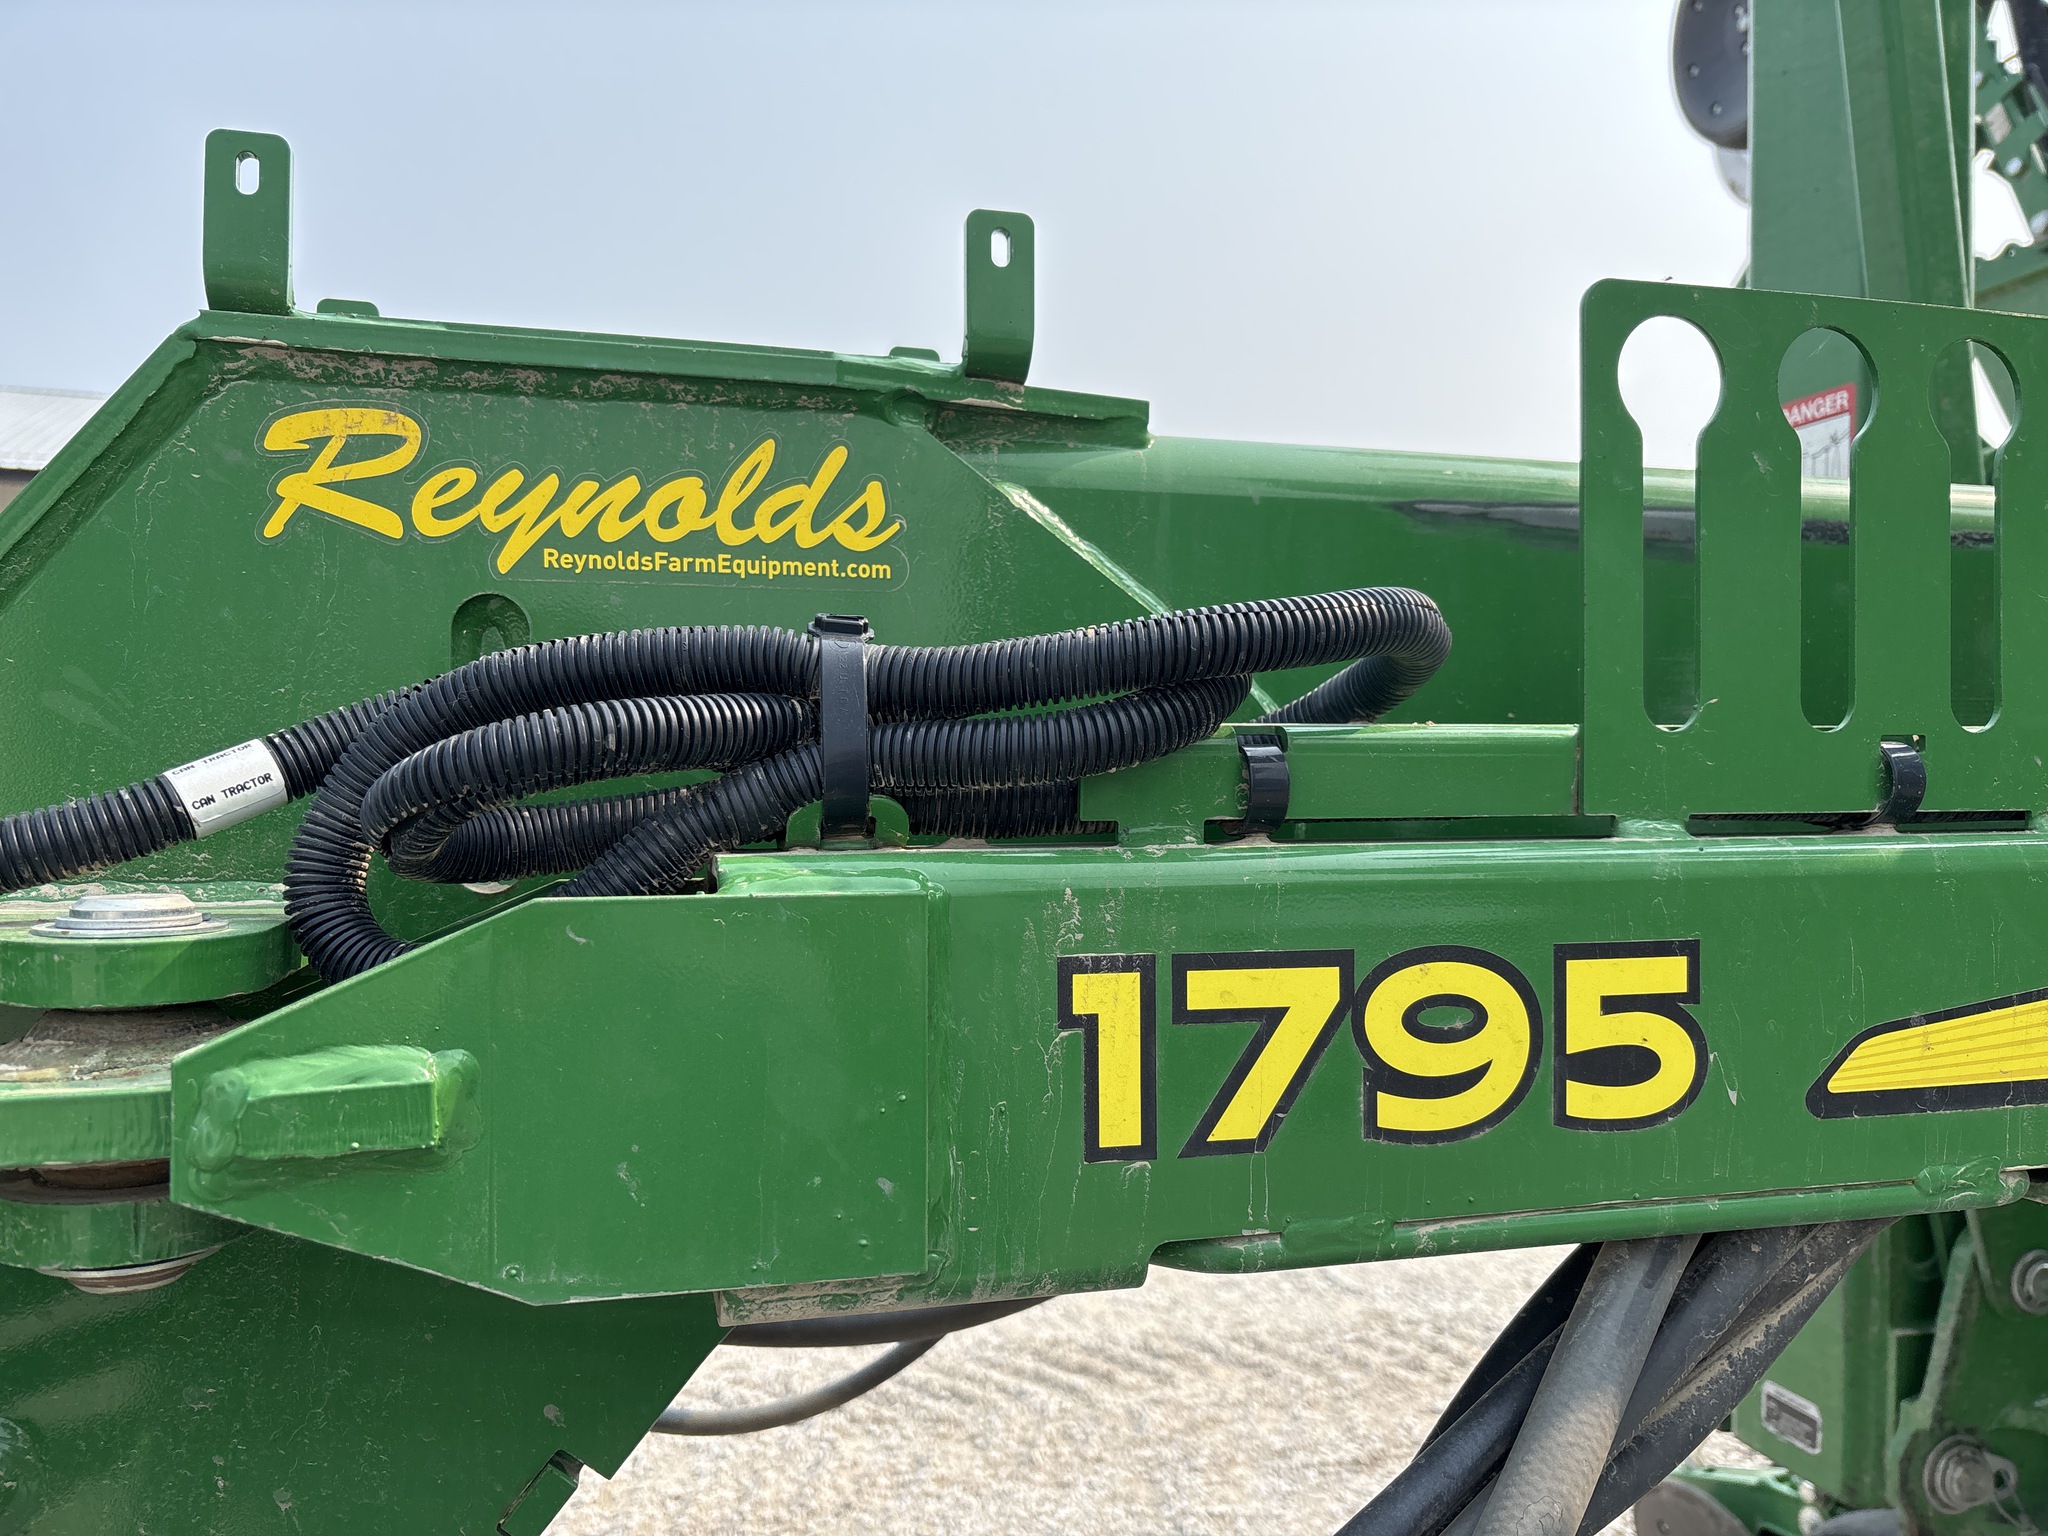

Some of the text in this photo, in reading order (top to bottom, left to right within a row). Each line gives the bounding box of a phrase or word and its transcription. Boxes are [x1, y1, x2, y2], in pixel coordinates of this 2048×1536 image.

[263, 407, 900, 574] Reynolds
[543, 547, 893, 580] ReynoldsFarmEquipment.com
[171, 743, 253, 776] CAN TRACTOR
[191, 772, 274, 811] CAN TRACTOR
[1071, 955, 1697, 1149] 1795
